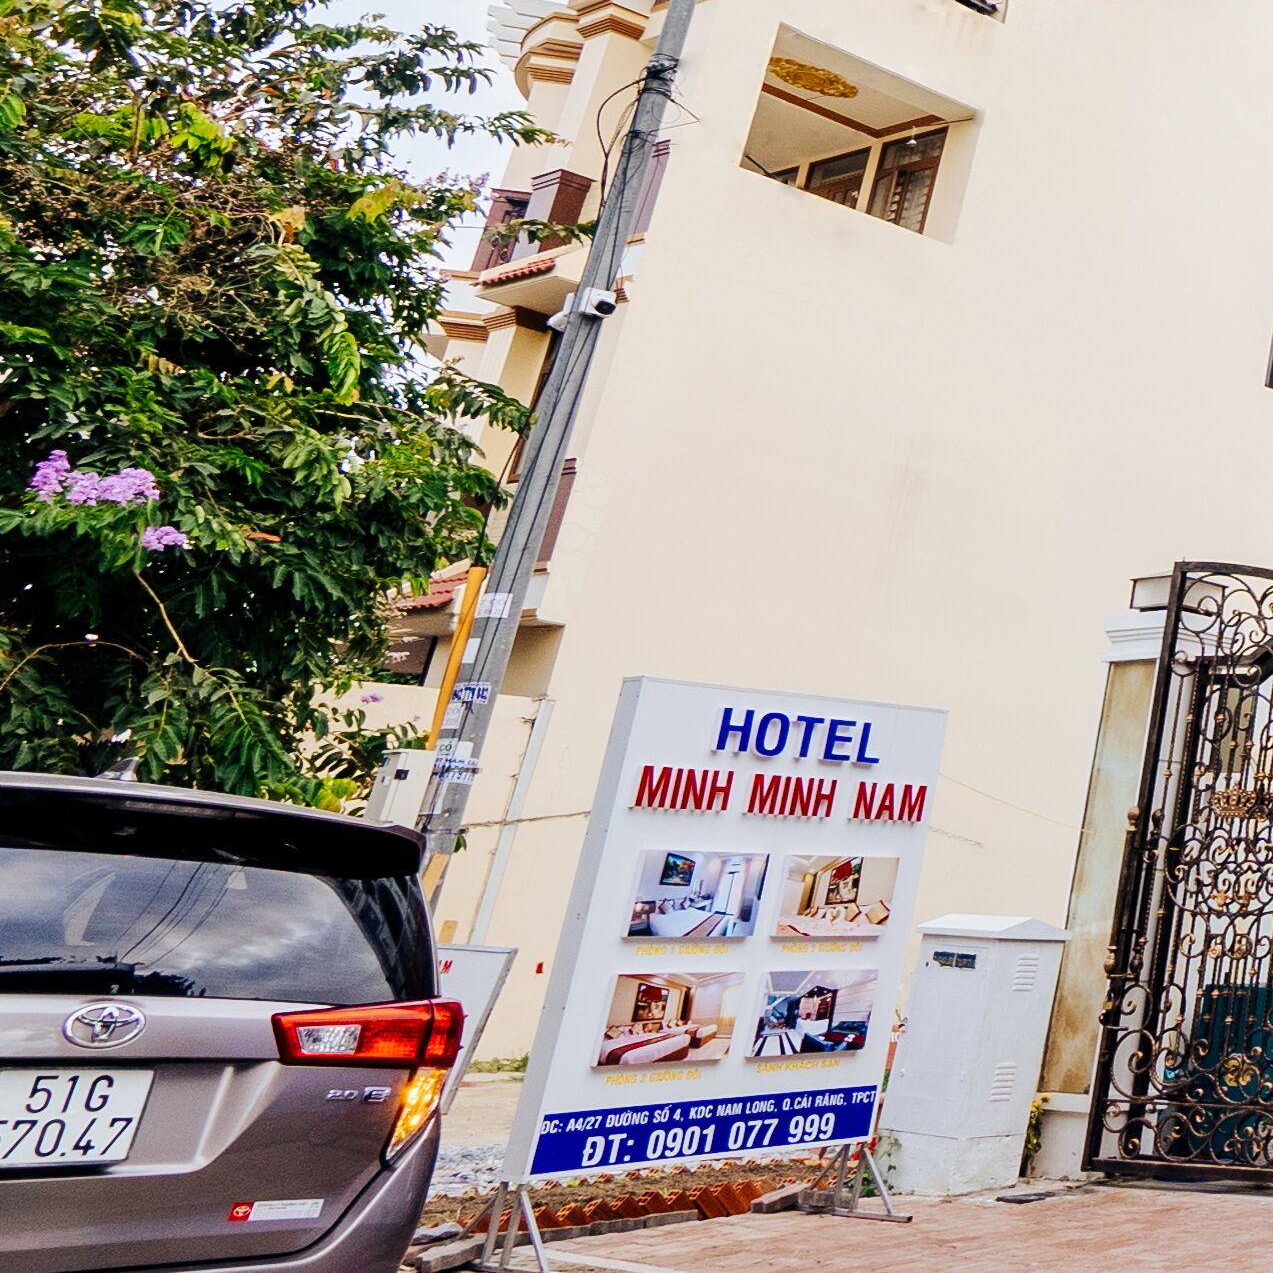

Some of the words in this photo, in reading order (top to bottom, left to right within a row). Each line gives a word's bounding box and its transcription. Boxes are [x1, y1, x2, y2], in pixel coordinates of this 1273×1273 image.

[713, 706, 881, 765] HOTEL
[633, 764, 735, 812] MINH
[746, 772, 838, 819] MINH
[852, 780, 928, 823] NAM
[25, 1074, 115, 1114] 51G
[566, 1115, 602, 1133] A4/27
[653, 1104, 674, 1124] SỐ
[689, 1104, 714, 1120] KDC
[716, 1102, 743, 1118] NAM
[852, 1090, 877, 1106] TPCT
[581, 1133, 635, 1167] ĐT:
[646, 1123, 716, 1160] 0901
[728, 1117, 778, 1151] 077
[787, 1112, 836, 1143] 999
